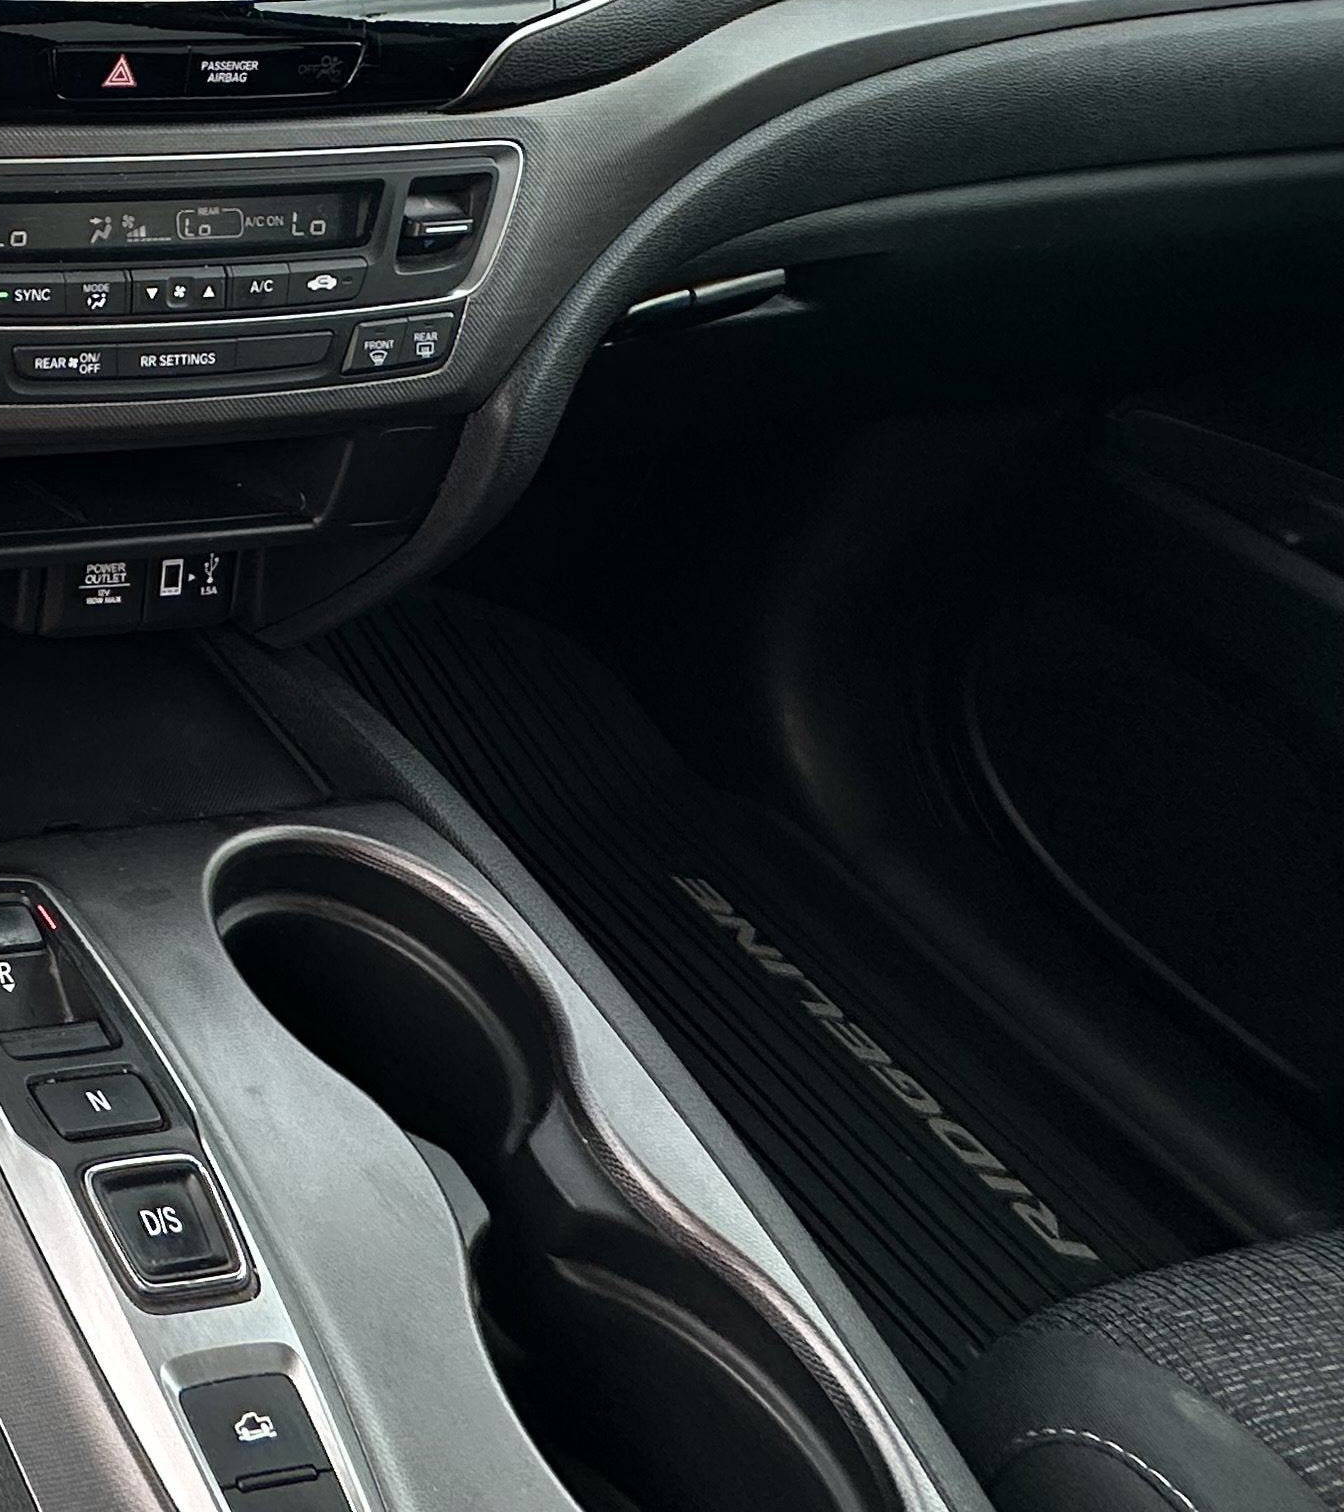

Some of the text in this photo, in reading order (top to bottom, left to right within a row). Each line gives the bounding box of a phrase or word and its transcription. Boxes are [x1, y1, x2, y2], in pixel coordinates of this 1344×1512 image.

[201, 61, 259, 71] PASSENGER
[207, 72, 248, 83] AIRBAG
[83, 282, 110, 294] MODE
[250, 279, 274, 294] A/C
[14, 288, 51, 303] SYNC
[414, 331, 438, 342] REAR
[364, 339, 394, 350] FRONT
[34, 356, 67, 370] REAR
[140, 352, 217, 368] RR SETTINGS
[79, 363, 101, 375] OFF
[86, 562, 127, 574] POWER
[84, 573, 127, 585] OUTLET
[671, 876, 1100, 1262] RIDGELINE
[84, 1090, 113, 1114] N
[138, 1206, 184, 1238] D/S
